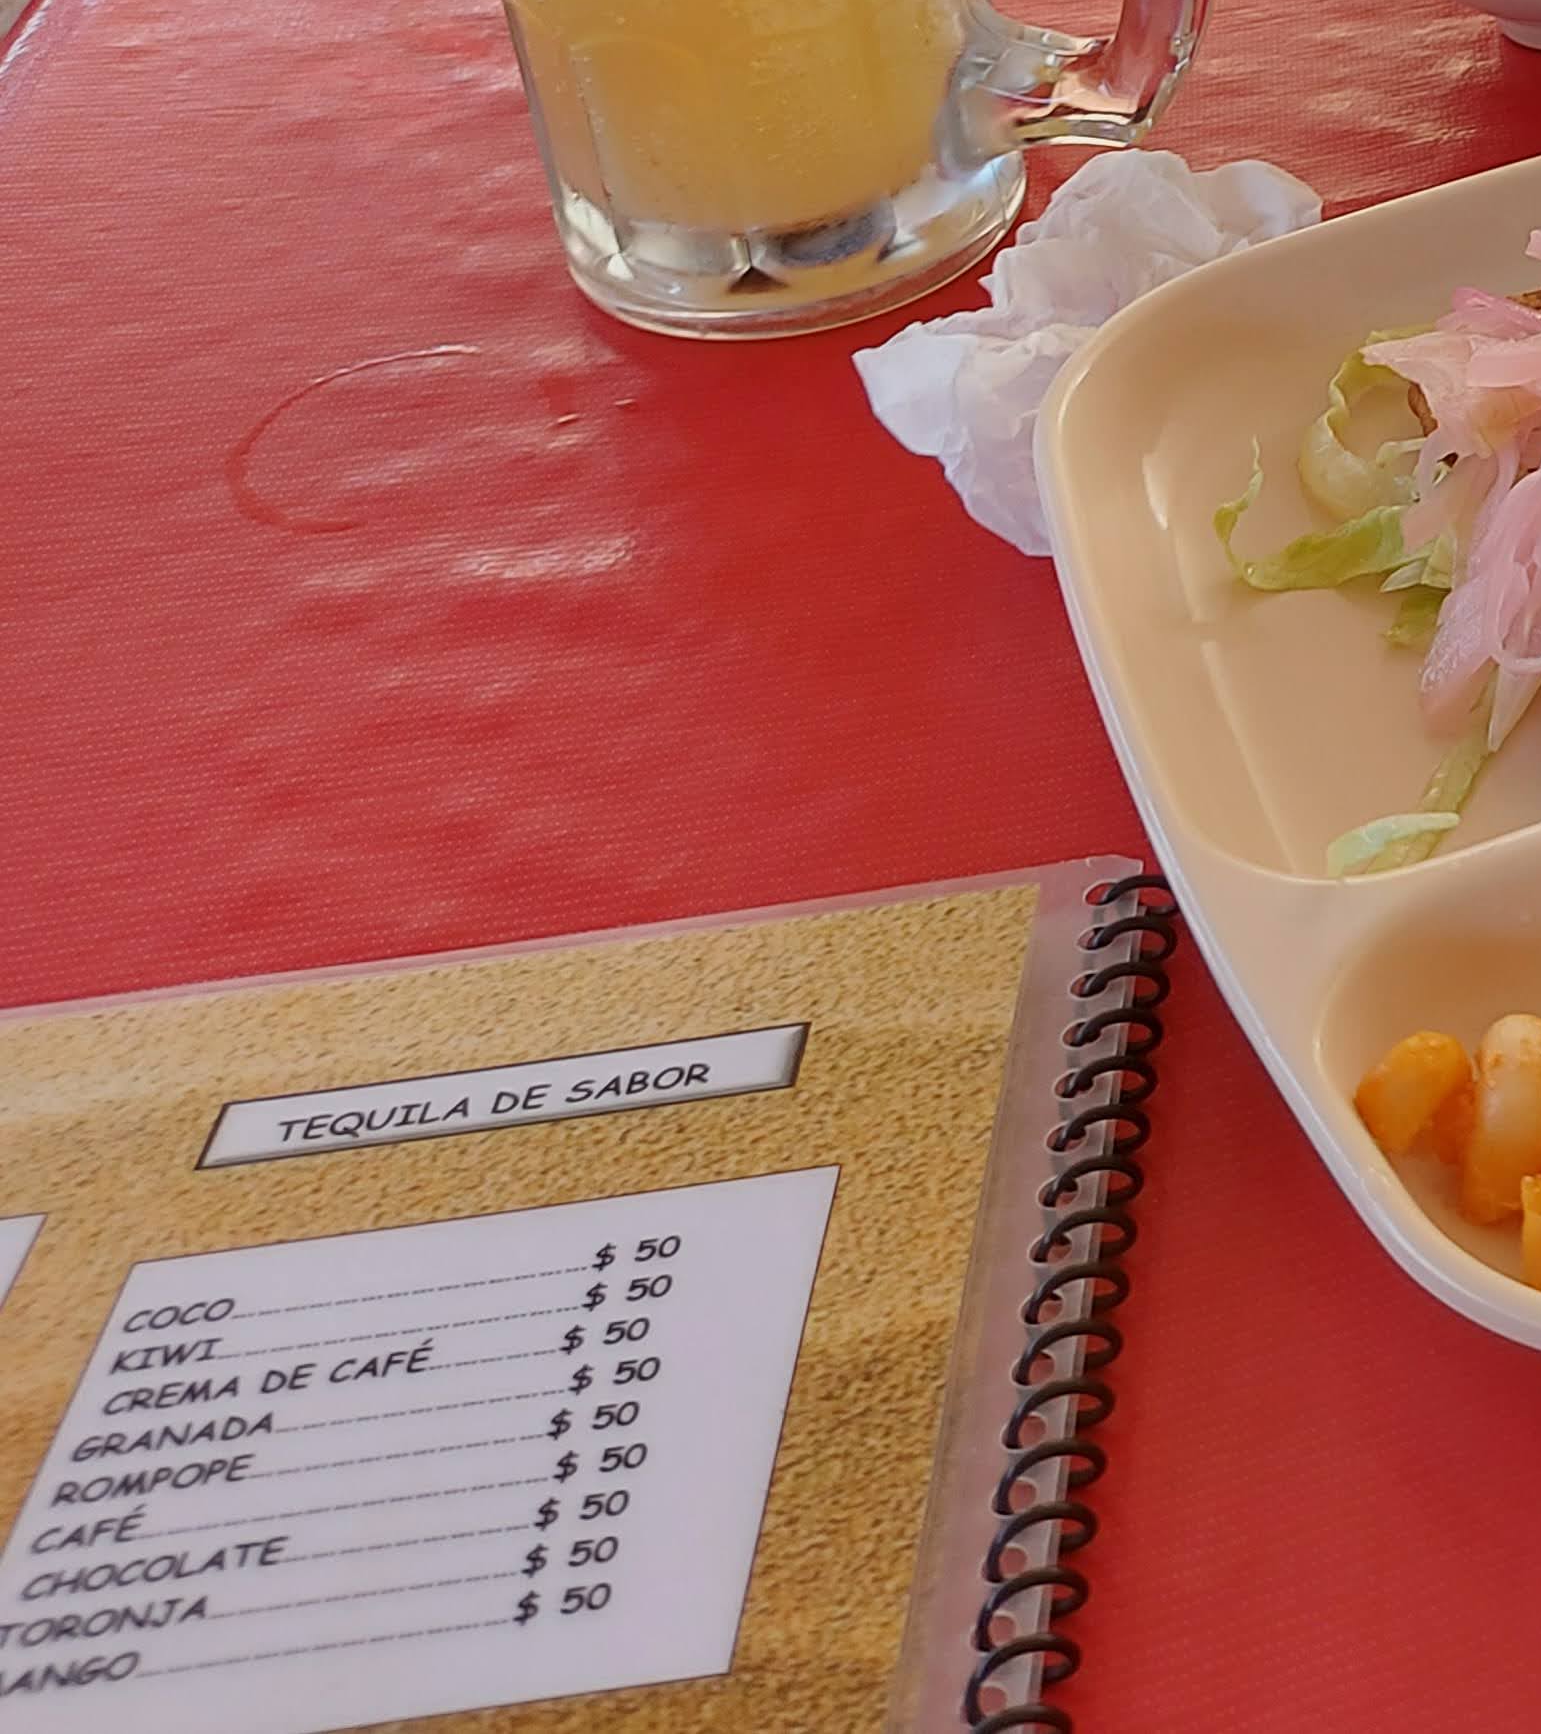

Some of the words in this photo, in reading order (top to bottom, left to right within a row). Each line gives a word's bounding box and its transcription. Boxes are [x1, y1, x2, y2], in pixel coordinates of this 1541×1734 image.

[278, 1098, 470, 1143] TEQUILA
[490, 1082, 552, 1115] DE
[565, 1063, 711, 1104] SABOR
[109, 1337, 224, 1375] KIWI
[625, 1274, 673, 1302] 50
[122, 1298, 236, 1333] COCO
[634, 1235, 682, 1262] 50
[71, 1412, 275, 1463] GRANADA
[612, 1357, 661, 1386] 50
[102, 1376, 241, 1416] CREMA
[260, 1363, 317, 1394] DE
[329, 1338, 434, 1384] CAFÉ
[602, 1317, 650, 1345] 50
[30, 1504, 147, 1554] CAFÉ
[598, 1443, 648, 1473] 50
[51, 1454, 256, 1507] ROMPOPE
[590, 1401, 640, 1431] 50
[0, 1596, 208, 1650] TORONJA
[567, 1536, 619, 1567] 50
[20, 1536, 290, 1602] CHOCOLATE
[578, 1489, 630, 1520] 50
[0, 1651, 140, 1697] ANGO
[559, 1583, 612, 1615] 50
